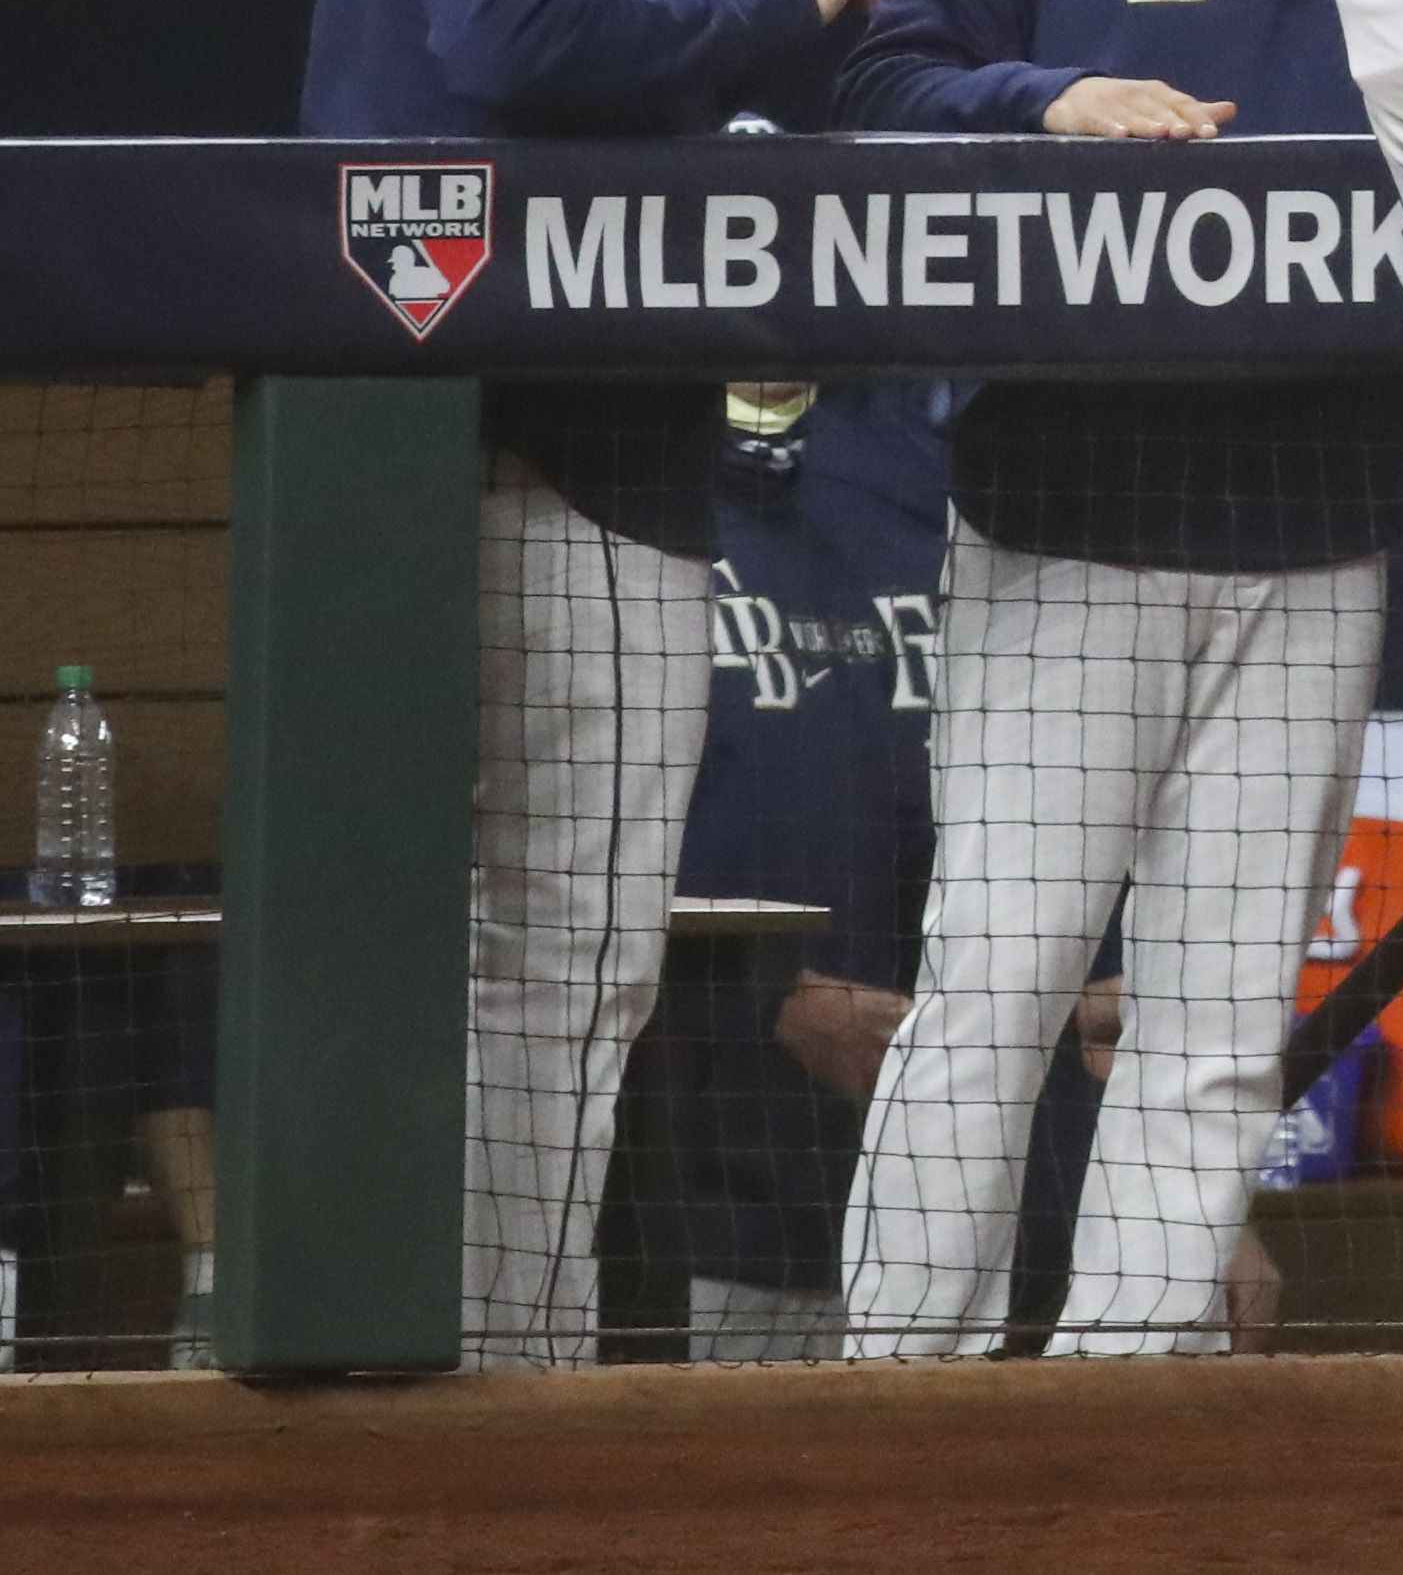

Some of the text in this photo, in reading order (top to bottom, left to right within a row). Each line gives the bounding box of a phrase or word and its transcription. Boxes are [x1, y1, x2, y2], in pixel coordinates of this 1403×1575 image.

[350, 174, 482, 221] MLB
[351, 222, 482, 238] NETWORK
[525, 194, 782, 309] MLB
